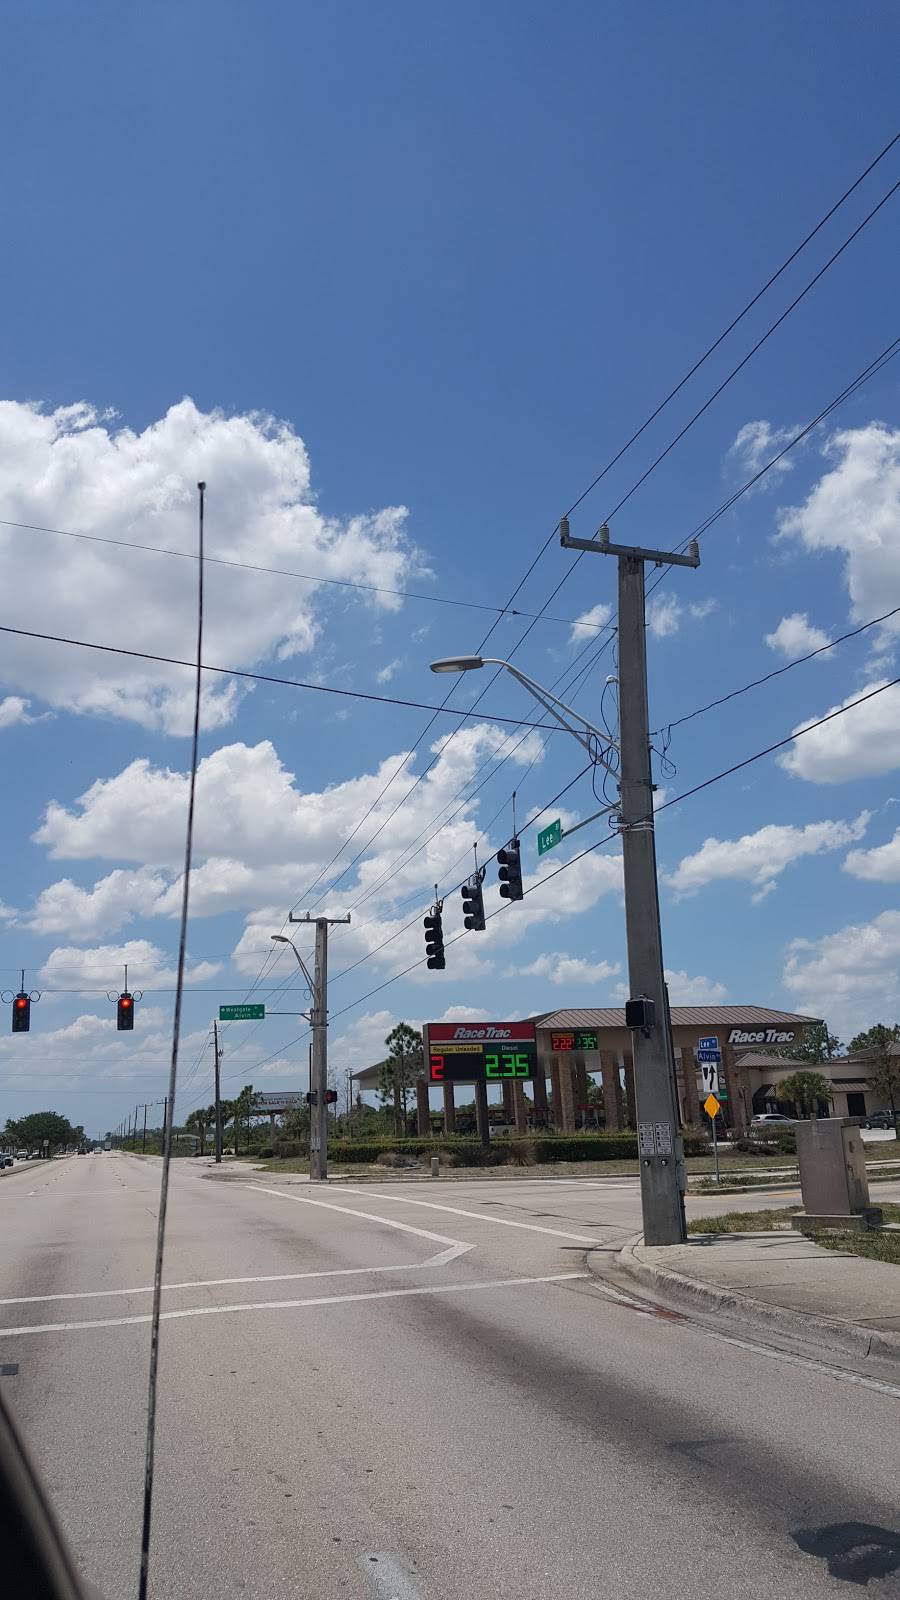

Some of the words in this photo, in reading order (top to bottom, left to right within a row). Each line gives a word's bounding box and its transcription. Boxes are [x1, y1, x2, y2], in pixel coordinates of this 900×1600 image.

[541, 833, 553, 849] Lee
[453, 1026, 512, 1039] RaceTrac
[728, 1029, 795, 1043] RaceTrac
[698, 1052, 715, 1060] Alvin
[431, 1055, 444, 1079] 2
